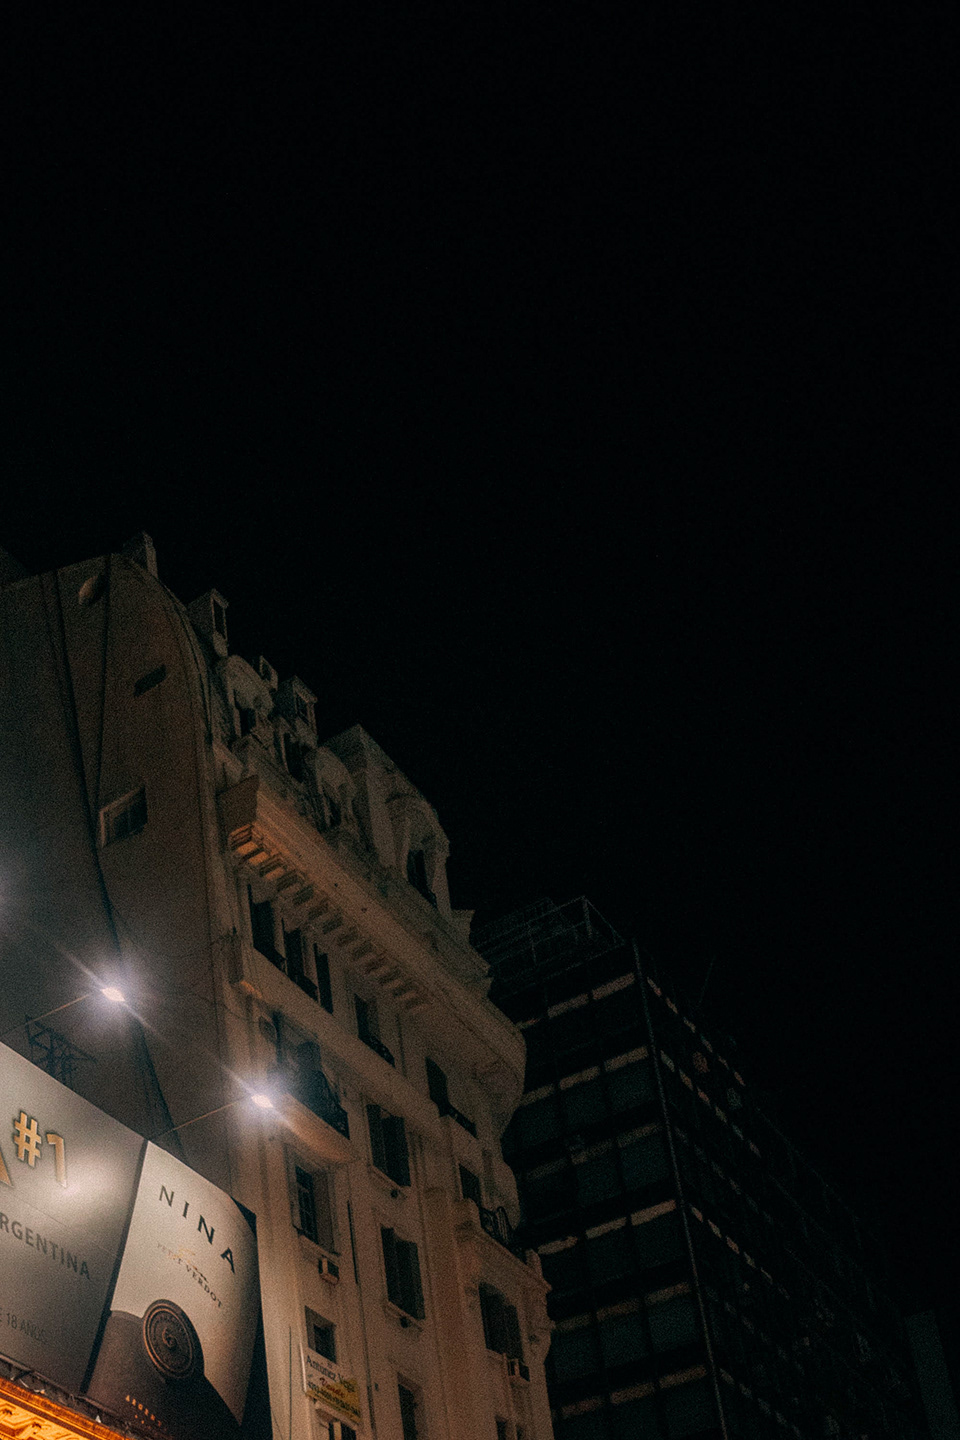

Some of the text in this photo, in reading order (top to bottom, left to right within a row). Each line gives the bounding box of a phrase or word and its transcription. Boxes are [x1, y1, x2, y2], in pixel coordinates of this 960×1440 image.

[12, 1109, 68, 1189] #1
[159, 1185, 235, 1273] NINA
[7, 1312, 18, 1329] 18
